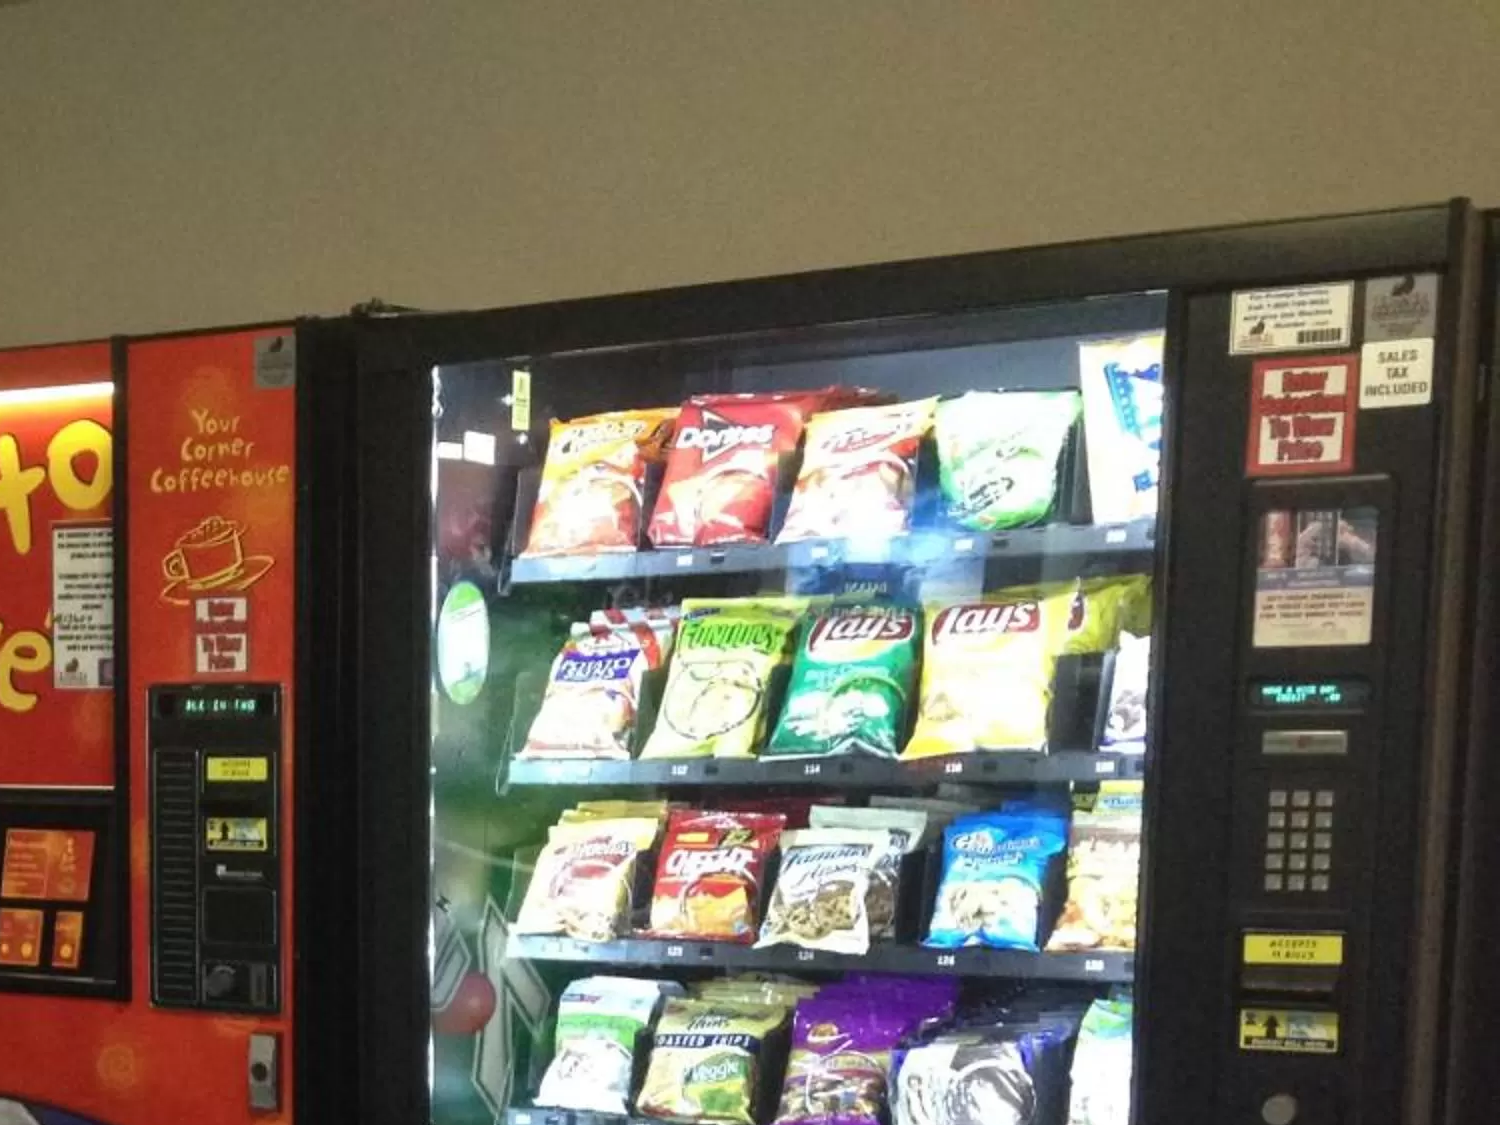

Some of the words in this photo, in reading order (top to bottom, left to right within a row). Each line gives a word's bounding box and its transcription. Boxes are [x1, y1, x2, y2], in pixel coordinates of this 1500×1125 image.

[1377, 348, 1419, 364] SALES
[1386, 367, 1409, 380] TAX
[1364, 381, 1429, 397] INCLUDED
[191, 409, 241, 434] Your
[674, 424, 775, 453] Doritos
[180, 437, 255, 462] Corner
[150, 463, 291, 494] Coffeehouse
[655, 1035, 706, 1047] OASTED
